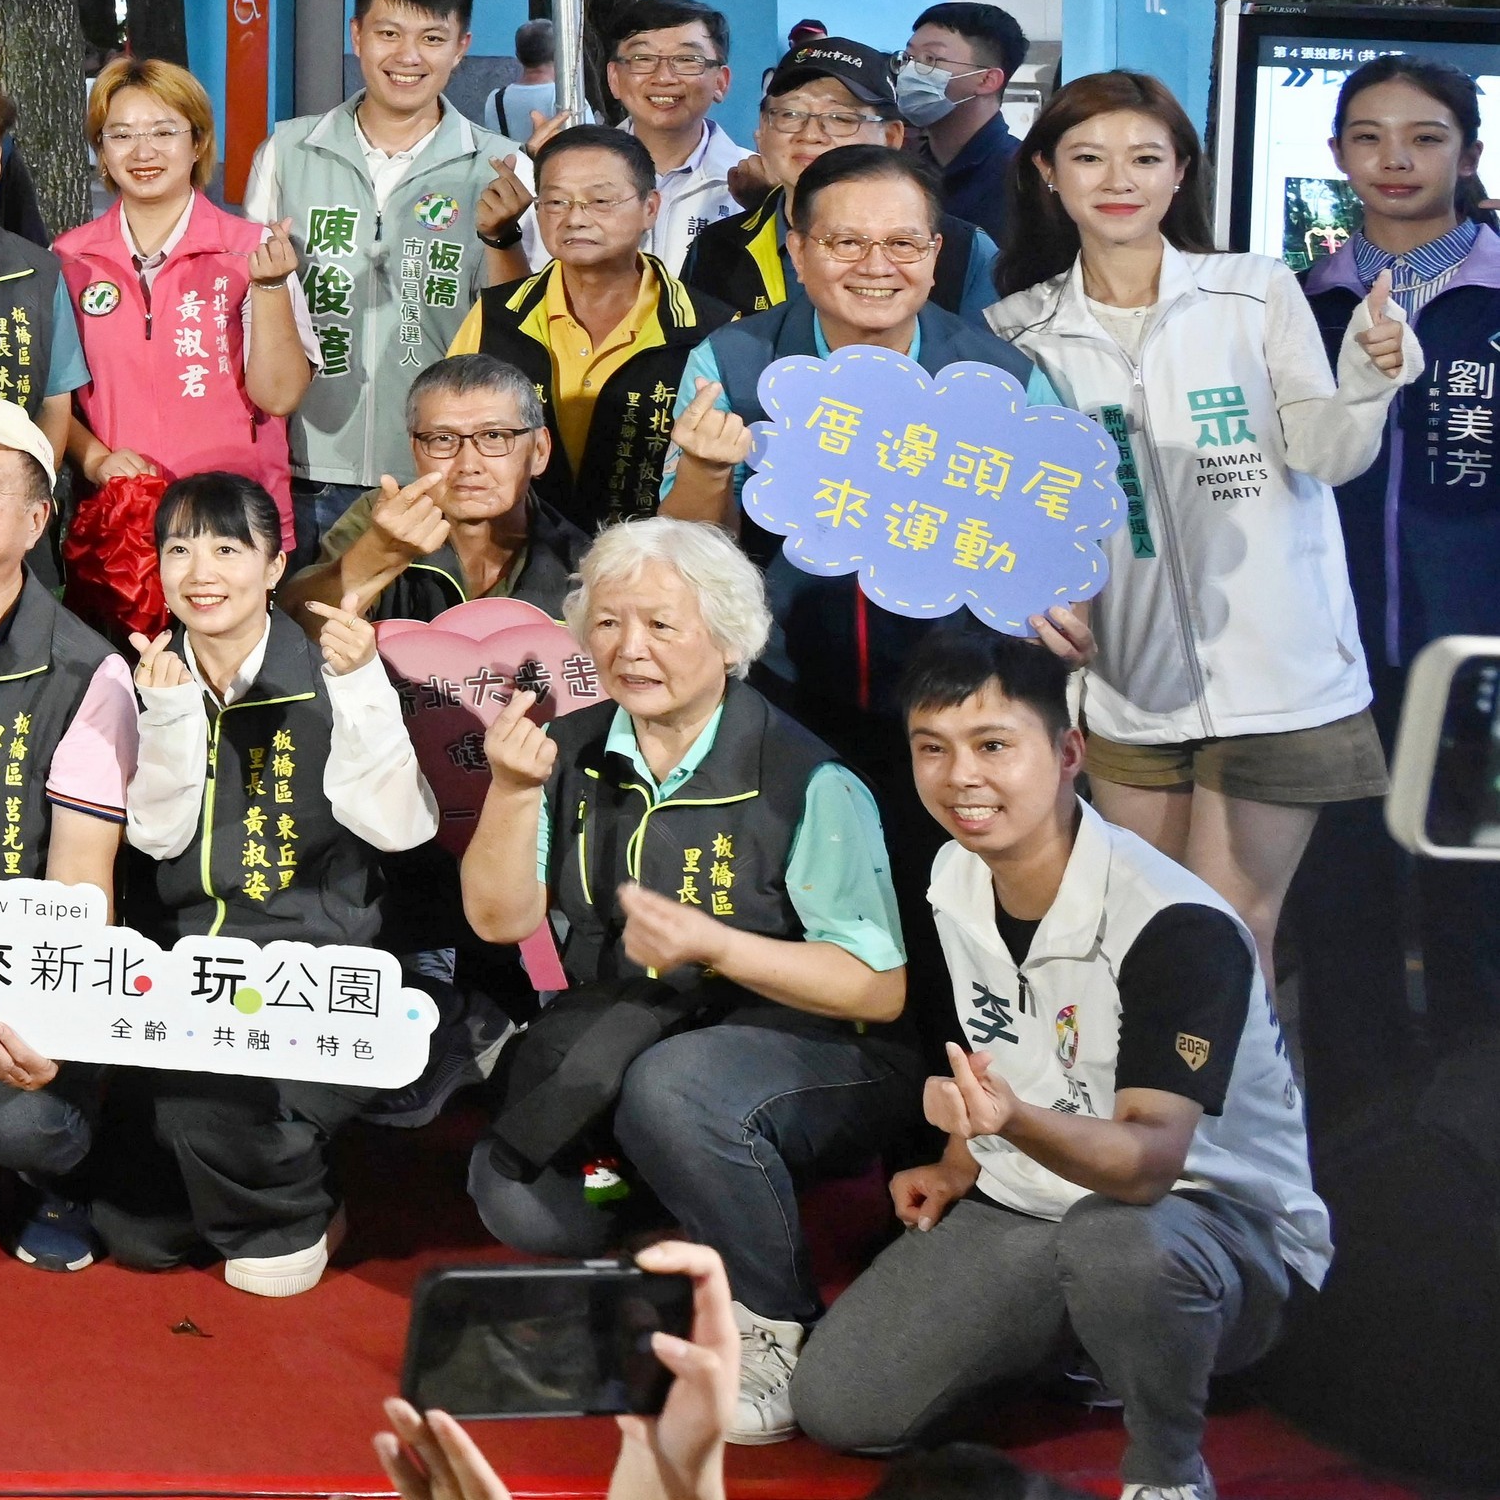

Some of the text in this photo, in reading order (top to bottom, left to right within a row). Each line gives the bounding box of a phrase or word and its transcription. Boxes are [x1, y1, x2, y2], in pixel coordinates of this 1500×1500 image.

[810, 49, 863, 68] 新北市政府
[1273, 46, 1287, 60] 第
[1290, 49, 1298, 59] 4
[1300, 46, 1354, 62] 張投影片
[400, 237, 426, 369] 市議員候選人
[425, 239, 464, 308] 板橋
[10, 306, 32, 366] 板橋區
[173, 290, 210, 398] 黃淑君
[211, 275, 231, 375] 新北市議員
[634, 380, 677, 511] 新北市板橋
[805, 396, 1082, 520] 厝邊頭尾
[1196, 452, 1262, 470] TAIWAN
[1446, 359, 1495, 487] 劉美芳
[1196, 469, 1268, 487] PEOPLE'S
[1211, 486, 1262, 501] PARTY
[813, 478, 1017, 573] 來運動
[2, 711, 32, 875] 板橋區 莒光里
[242, 747, 272, 902] 里長 黃淑姿
[271, 729, 299, 890] 板橋區 東丘里
[22, 898, 89, 920] Taipei
[676, 847, 702, 904] 里長
[709, 832, 735, 915] 板橋區
[191, 955, 383, 1018] 玩公園
[1178, 1035, 1208, 1056] 2024
